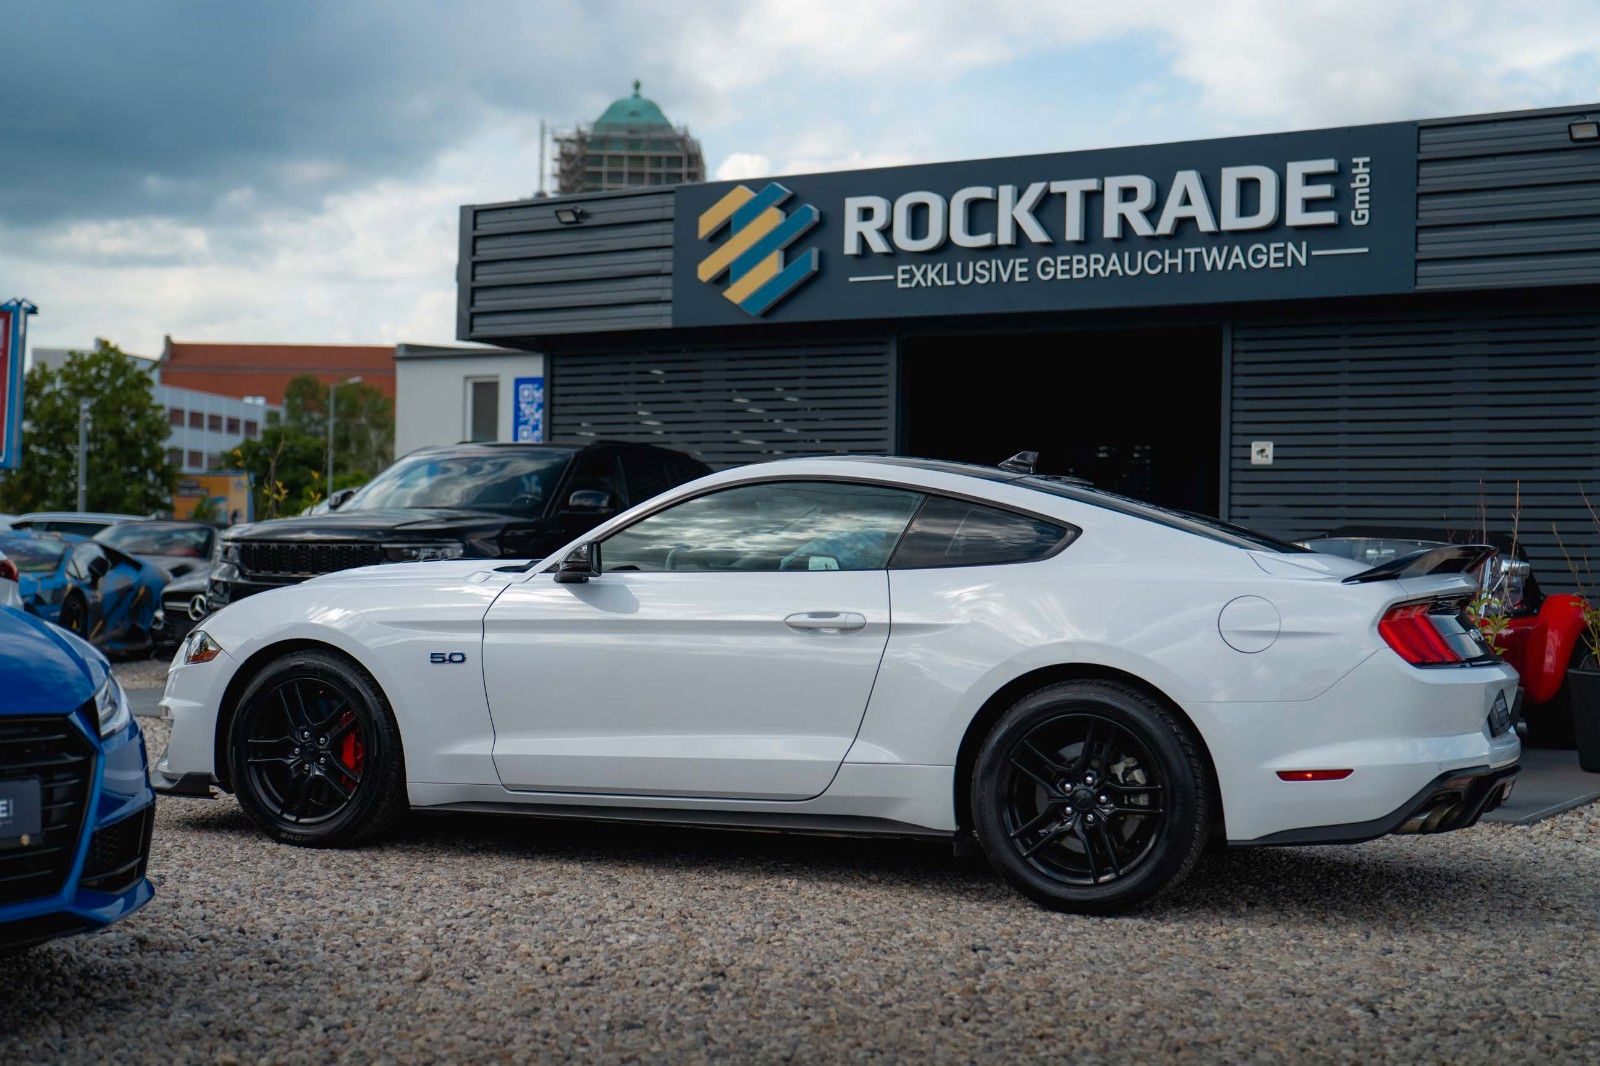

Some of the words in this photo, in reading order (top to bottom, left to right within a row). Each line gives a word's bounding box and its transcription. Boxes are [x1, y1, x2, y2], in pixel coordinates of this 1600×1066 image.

[843, 158, 1338, 256] ROCKTRADE
[1350, 157, 1371, 226] GmbH
[897, 259, 1030, 289] EXKLUSIVE
[1036, 241, 1307, 281] GEBRAUCHTWAGEN
